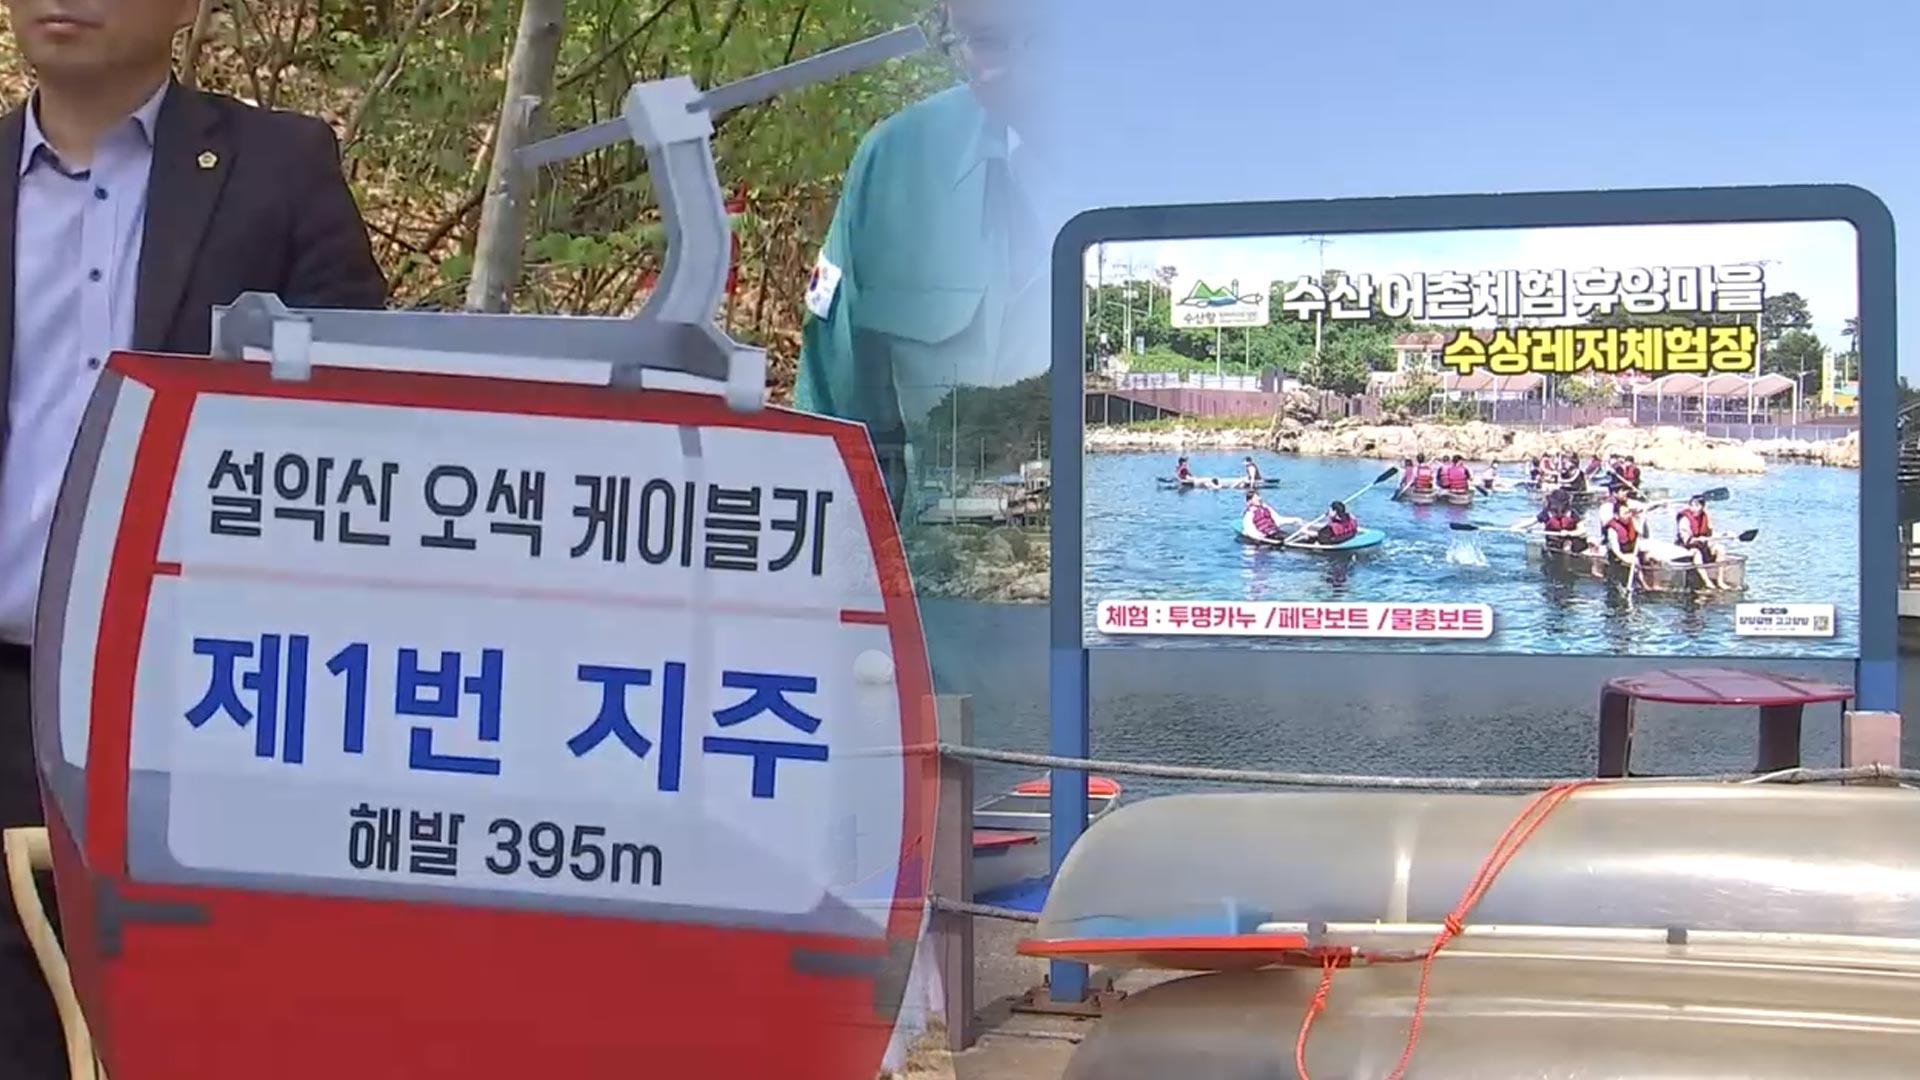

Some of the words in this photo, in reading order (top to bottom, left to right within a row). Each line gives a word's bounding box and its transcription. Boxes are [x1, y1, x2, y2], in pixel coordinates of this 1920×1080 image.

[1283, 273, 1375, 321] 수산
[1380, 269, 1567, 321] 어촌체험
[1572, 264, 1766, 317] 휴양마을
[1442, 323, 1758, 375] 수상레저체험장
[207, 448, 400, 547] 설악산
[420, 464, 547, 559] 오색
[569, 474, 834, 577] 케이블카
[1105, 604, 1149, 628] 체험
[1168, 605, 1258, 630] 투명카누
[183, 632, 504, 776] 제1번
[565, 660, 830, 799] 지주
[347, 802, 465, 877] 해발
[484, 817, 664, 887] 395m
